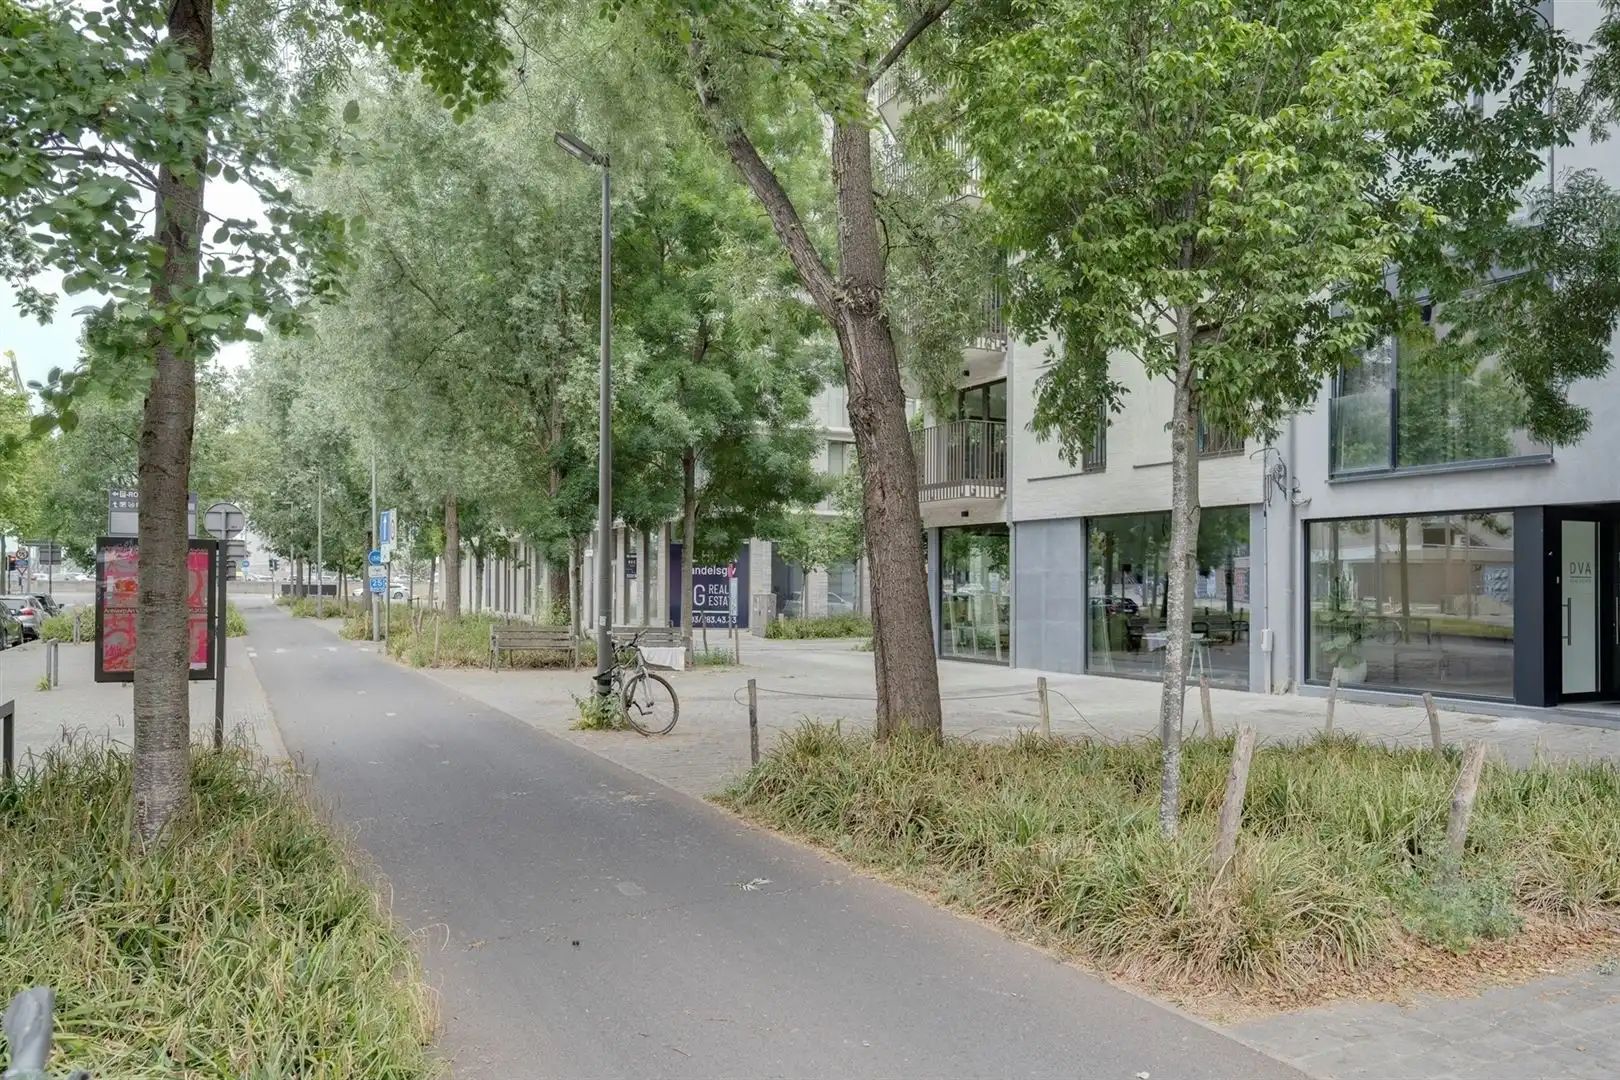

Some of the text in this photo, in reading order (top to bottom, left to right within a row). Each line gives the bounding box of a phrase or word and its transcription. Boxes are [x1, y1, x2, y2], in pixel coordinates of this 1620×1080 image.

[1570, 561, 1592, 575] DVA
[708, 584, 730, 595] REAL
[708, 595, 730, 607] ESTA
